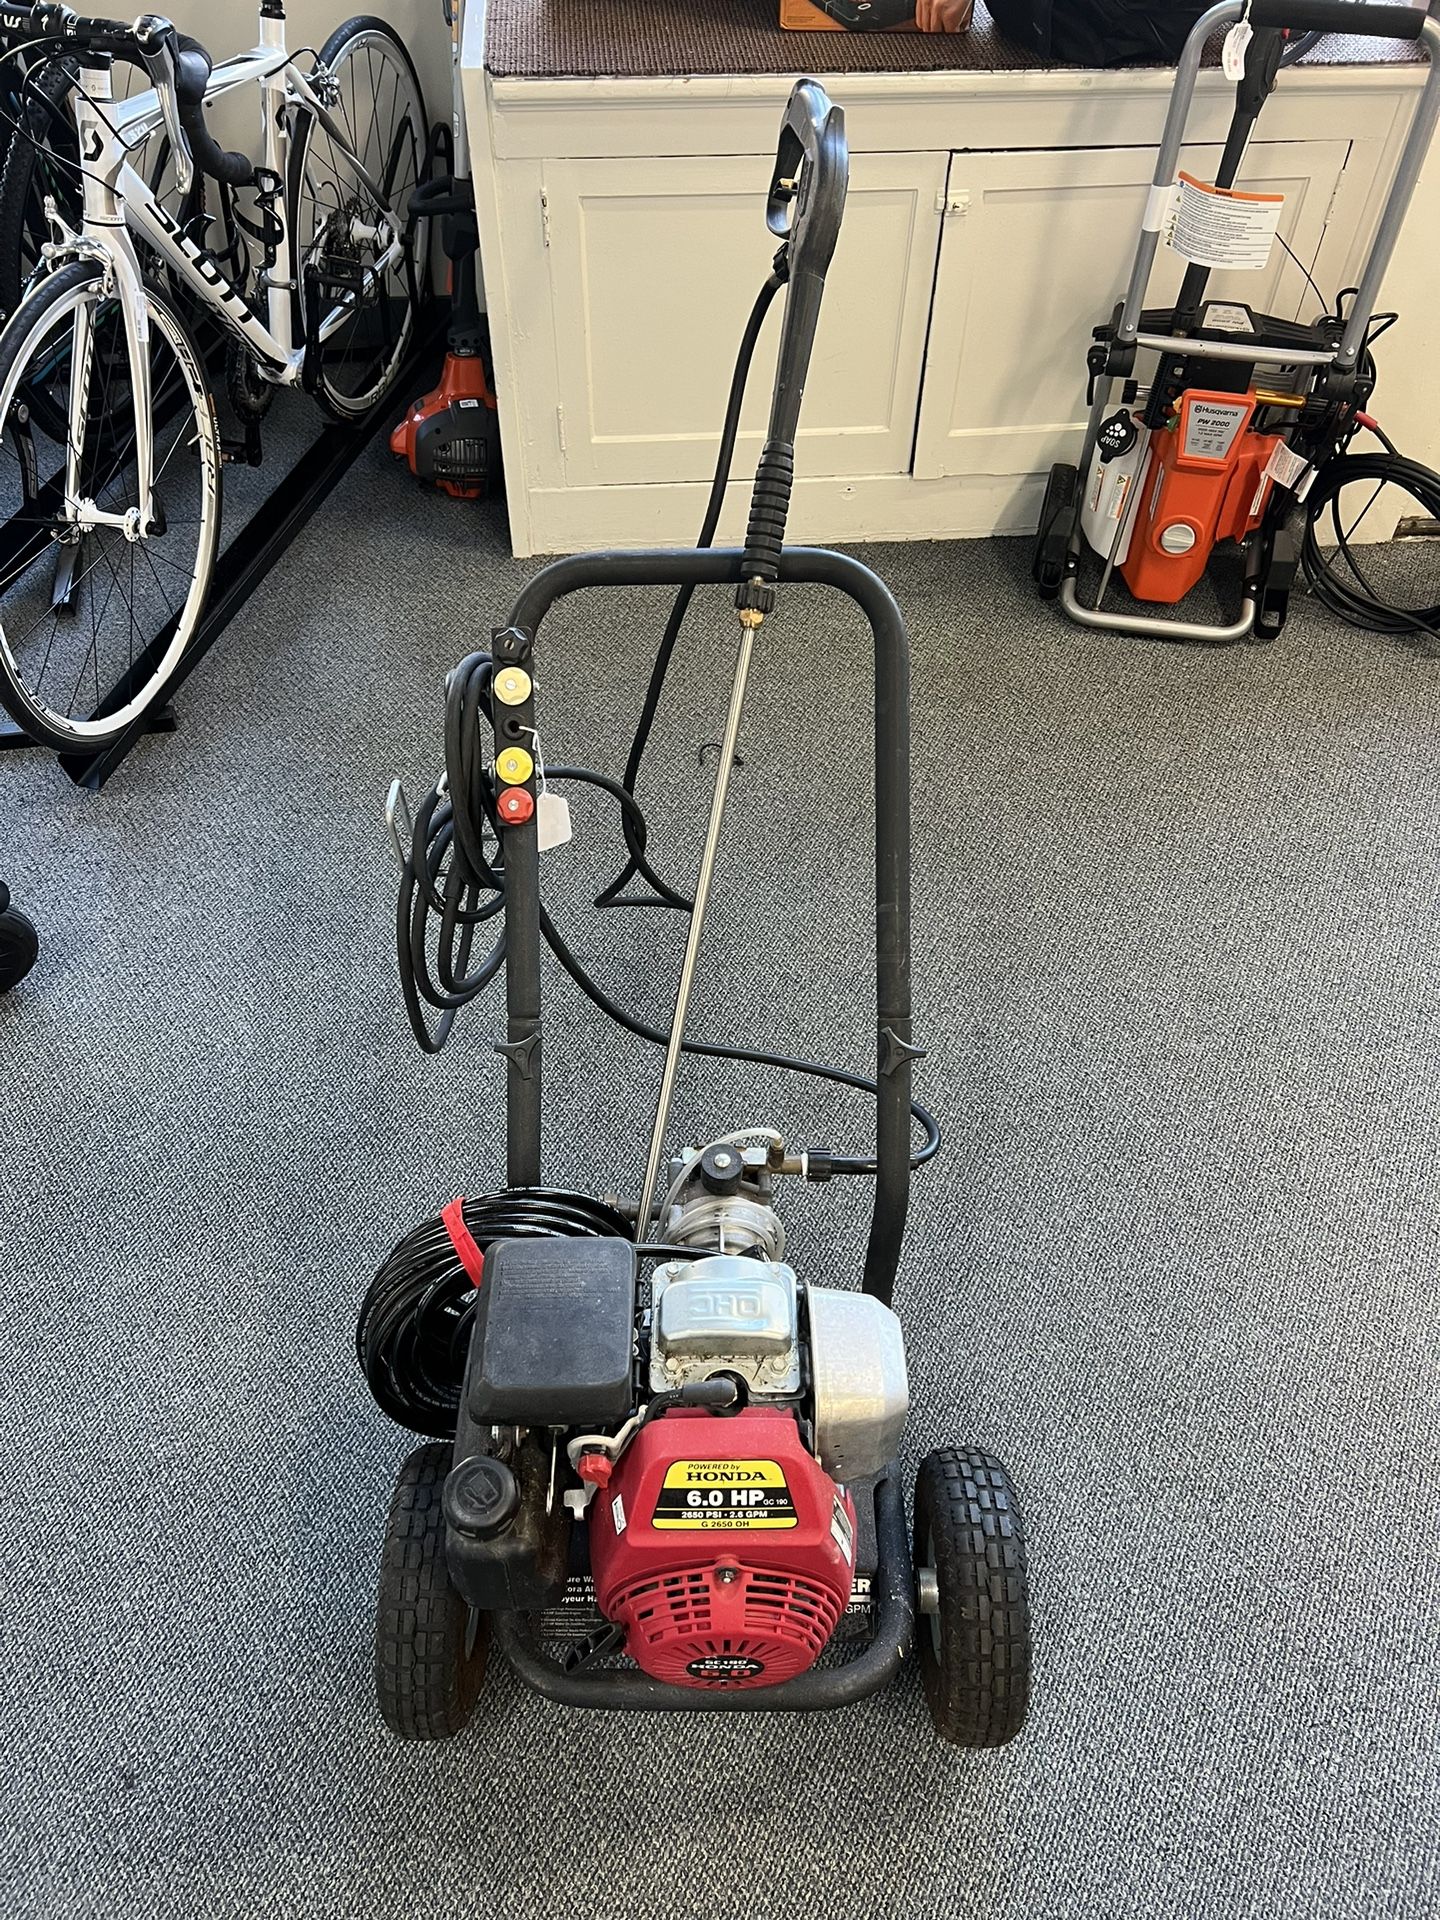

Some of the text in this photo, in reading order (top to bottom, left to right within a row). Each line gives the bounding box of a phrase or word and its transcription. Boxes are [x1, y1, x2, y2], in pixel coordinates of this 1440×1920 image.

[1202, 406, 1238, 416] Husqvarna
[1210, 419, 1230, 427] 2000
[1101, 435, 1120, 448] SOAP
[730, 1463, 741, 1471] by
[686, 1472, 767, 1481] HONDA
[686, 1490, 723, 1507] 6.0
[730, 1490, 765, 1506] HP
[681, 1511, 703, 1519] 2650
[845, 1604, 871, 1613] GPM
